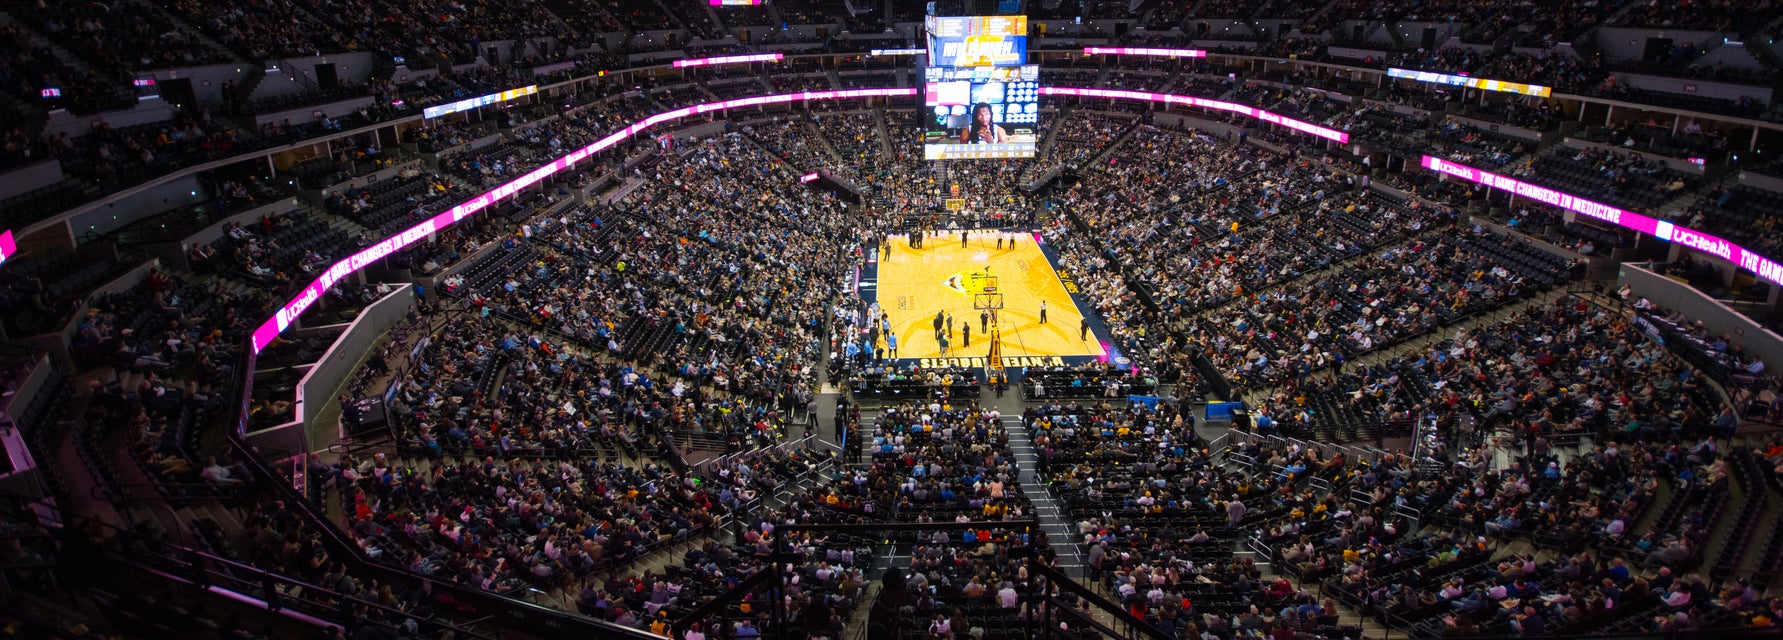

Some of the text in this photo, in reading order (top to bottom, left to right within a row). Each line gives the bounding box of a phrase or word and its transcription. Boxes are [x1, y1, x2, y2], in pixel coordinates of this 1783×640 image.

[1440, 161, 1621, 224] UCHealth THE GAME CHANGERS IN MEDICINE
[286, 219, 436, 322] UCHealth THE GAME CHANGERS IN MEDICINE
[1673, 228, 1731, 260] UCHealth
[1740, 248, 1759, 273] THE
